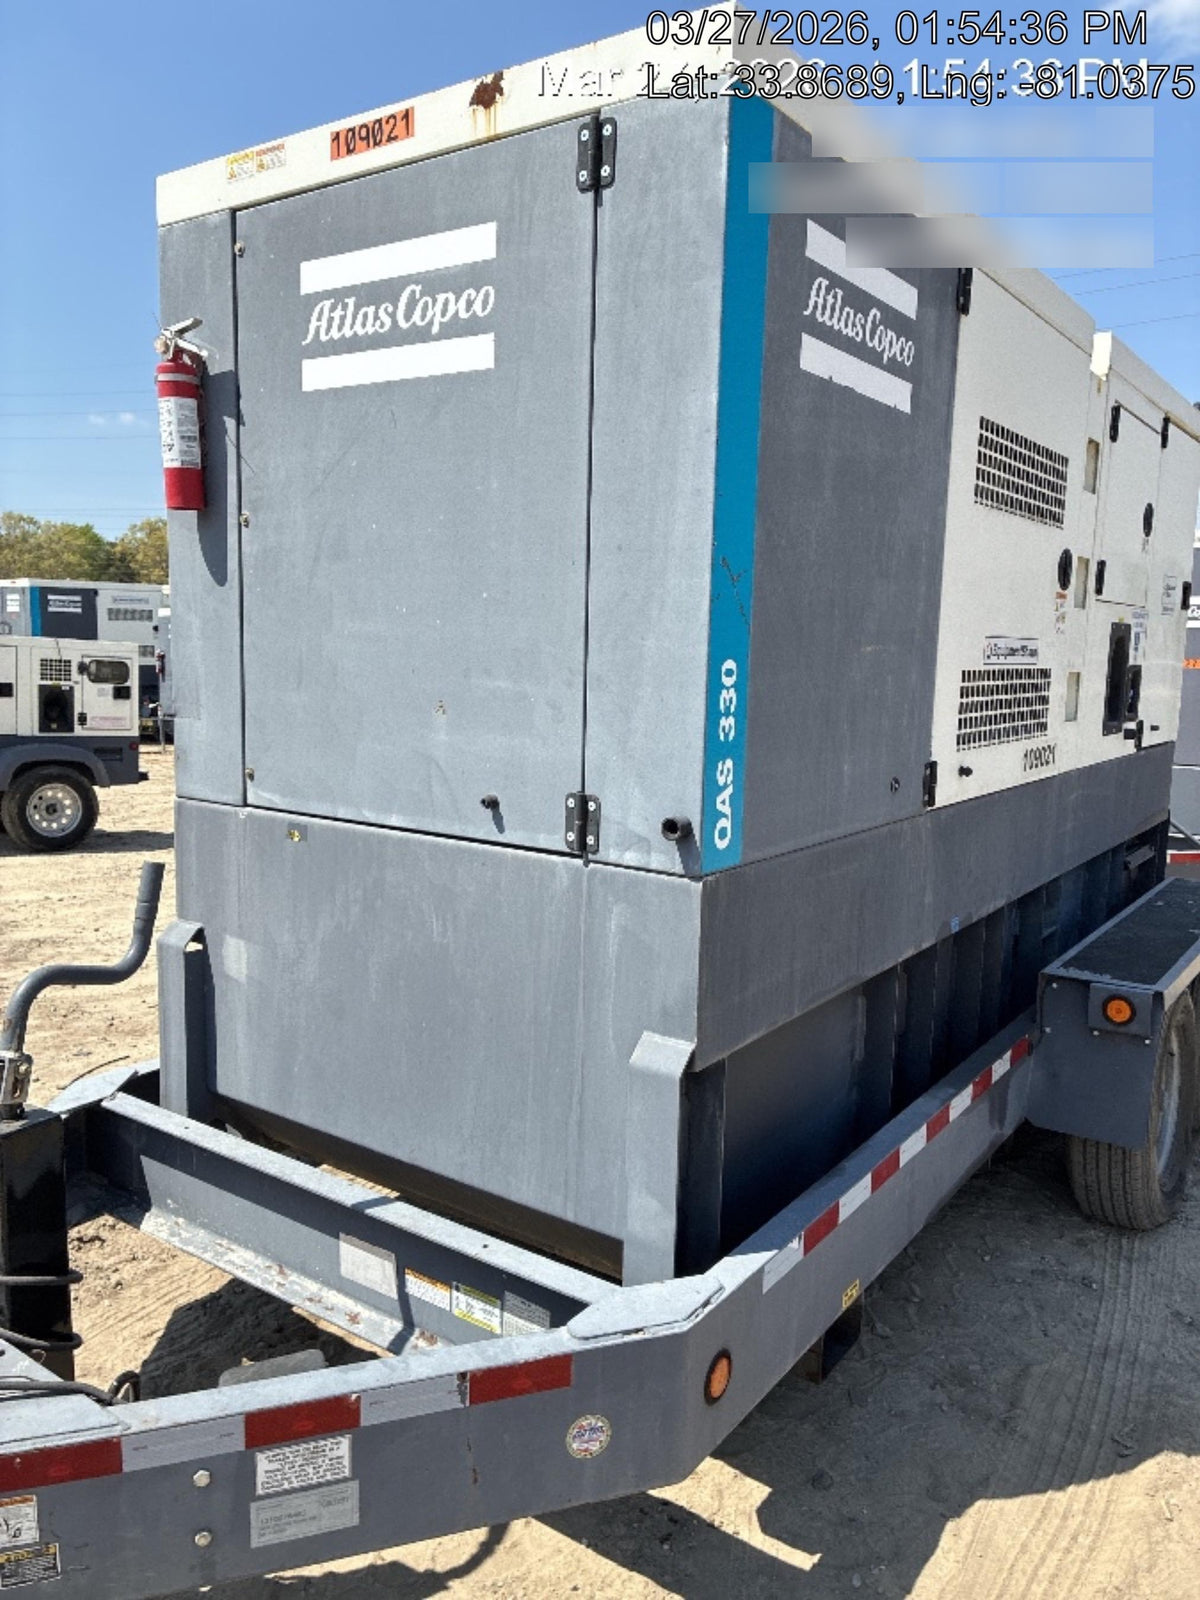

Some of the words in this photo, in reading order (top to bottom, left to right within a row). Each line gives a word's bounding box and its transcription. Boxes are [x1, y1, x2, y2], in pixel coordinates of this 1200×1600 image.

[332, 108, 410, 157] 109021
[302, 297, 394, 346] Atlas
[396, 284, 495, 336] Copco
[803, 277, 864, 342] Atlas
[866, 307, 915, 367] Copco
[718, 659, 738, 742] 330
[1023, 743, 1057, 772] 109021
[713, 758, 734, 850] QAS
